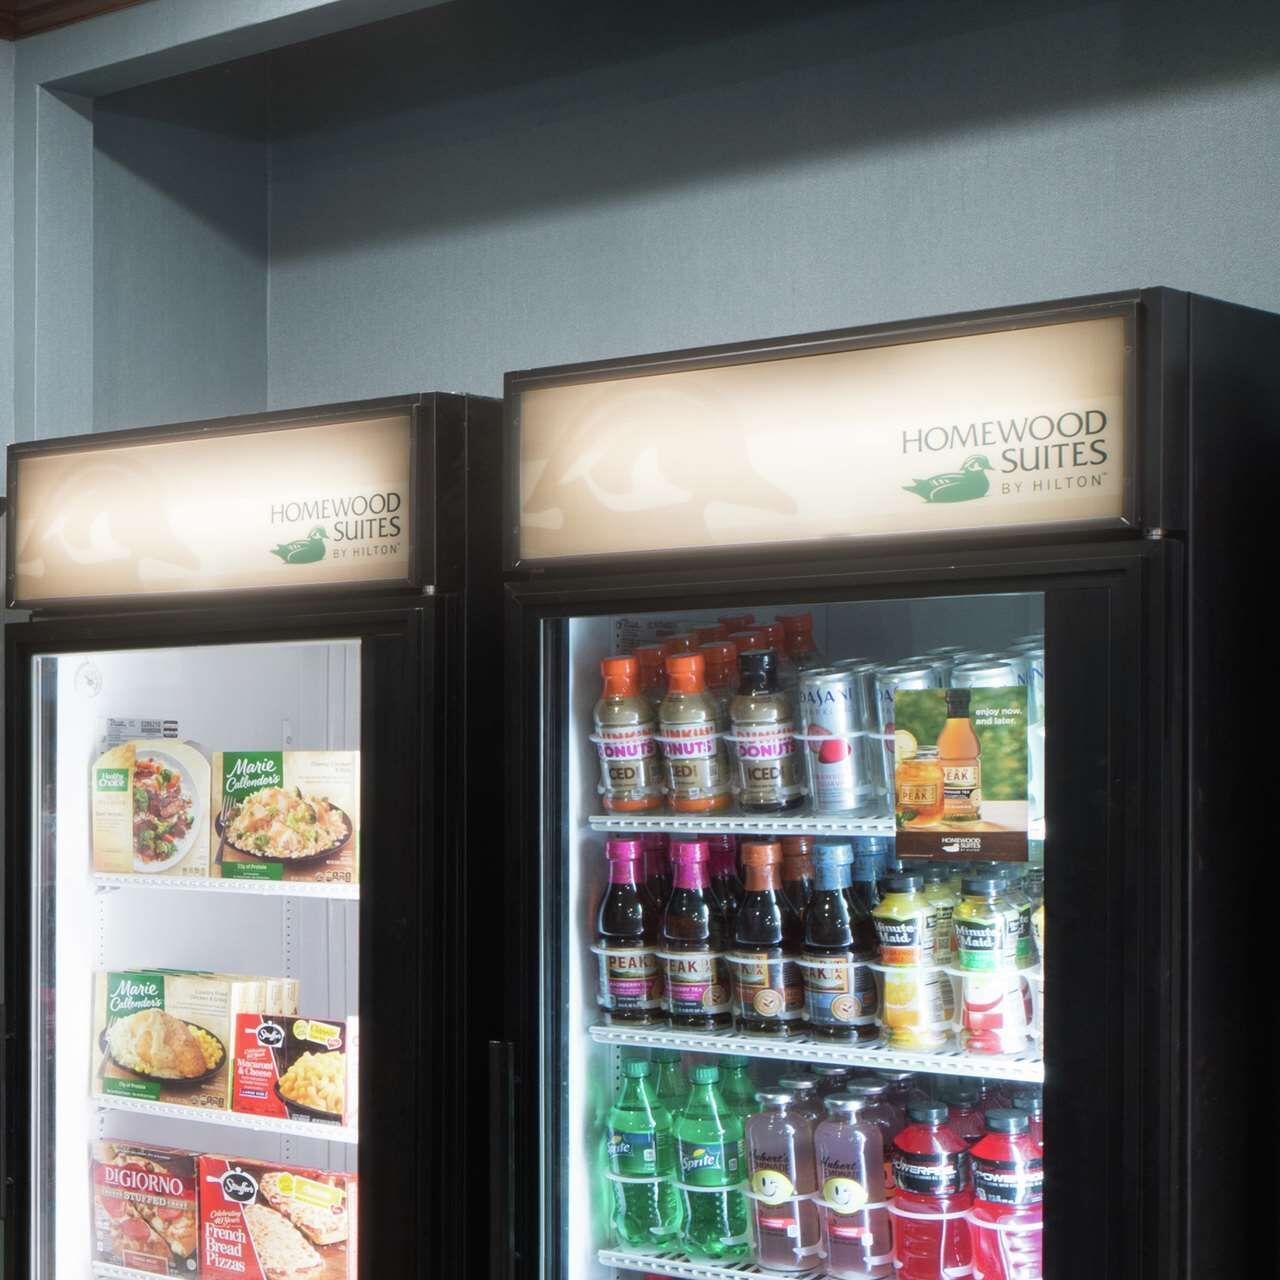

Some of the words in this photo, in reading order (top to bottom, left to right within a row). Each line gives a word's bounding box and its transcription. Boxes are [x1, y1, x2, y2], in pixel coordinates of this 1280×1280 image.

[902, 410, 1107, 454] HOMEWOOD
[1001, 439, 1108, 473] SUITES
[1002, 482, 1022, 495] BY
[1033, 474, 1102, 492] HILTON
[272, 493, 401, 524] HOMEWOOD
[334, 516, 401, 541] SUITES
[333, 549, 347, 558] BY
[353, 545, 397, 557] HILTON
[976, 706, 998, 717] enjoy
[1002, 706, 1022, 715] now.
[976, 717, 993, 726] and
[994, 716, 1017, 726] later.
[736, 741, 796, 760] DONUTS
[226, 758, 276, 778] Marie
[747, 763, 777, 780] ICED
[225, 773, 281, 793] Callender's
[902, 792, 928, 801] PEAK
[874, 920, 920, 934] Minute
[955, 924, 996, 938] Minute
[880, 931, 912, 944] Maid
[961, 935, 995, 947] Maid
[111, 979, 159, 998] Marie
[110, 994, 162, 1012] Callender's
[237, 1058, 273, 1070] Macaroni
[244, 1067, 273, 1079] Cheese
[682, 1154, 715, 1170] Sprite
[124, 1192, 166, 1206] STUFFED
[205, 1222, 247, 1244] French
[205, 1237, 242, 1257] Bread
[206, 1250, 246, 1273] Pizzas
